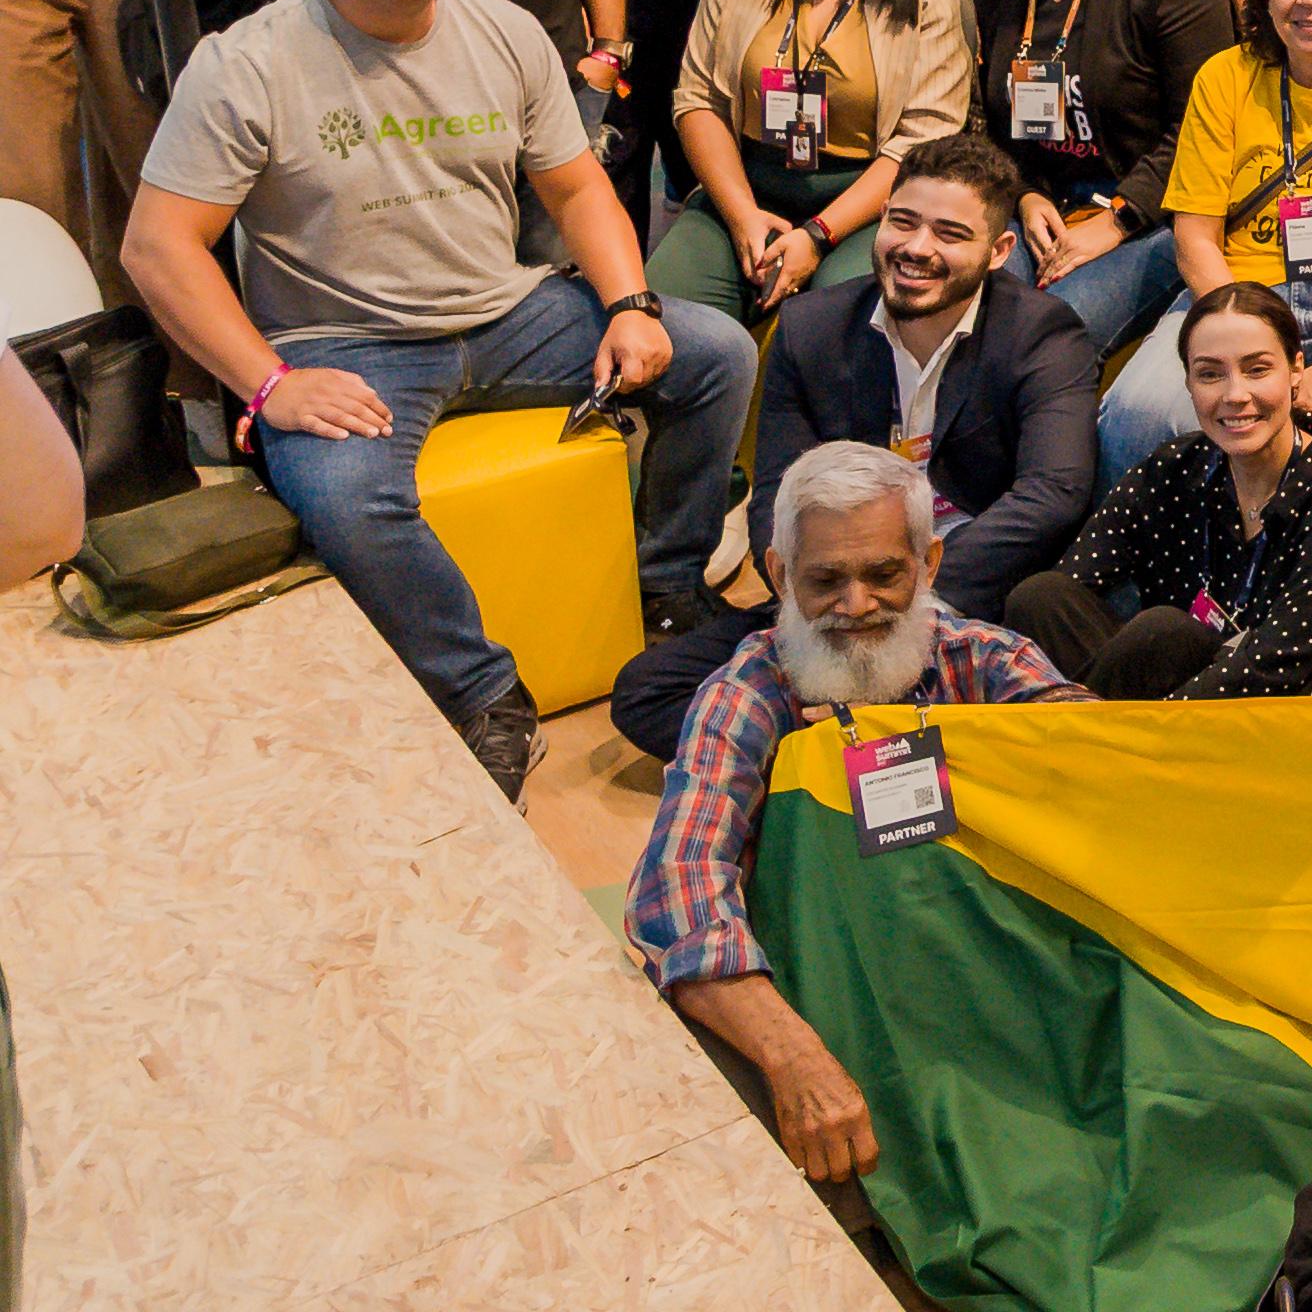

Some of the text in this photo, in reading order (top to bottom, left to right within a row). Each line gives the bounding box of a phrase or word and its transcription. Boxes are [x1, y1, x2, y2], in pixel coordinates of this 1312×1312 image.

[1026, 126, 1047, 135] GUEST
[360, 199, 392, 213] WEB
[875, 747, 911, 764] summit
[878, 821, 936, 845] PARTNER
